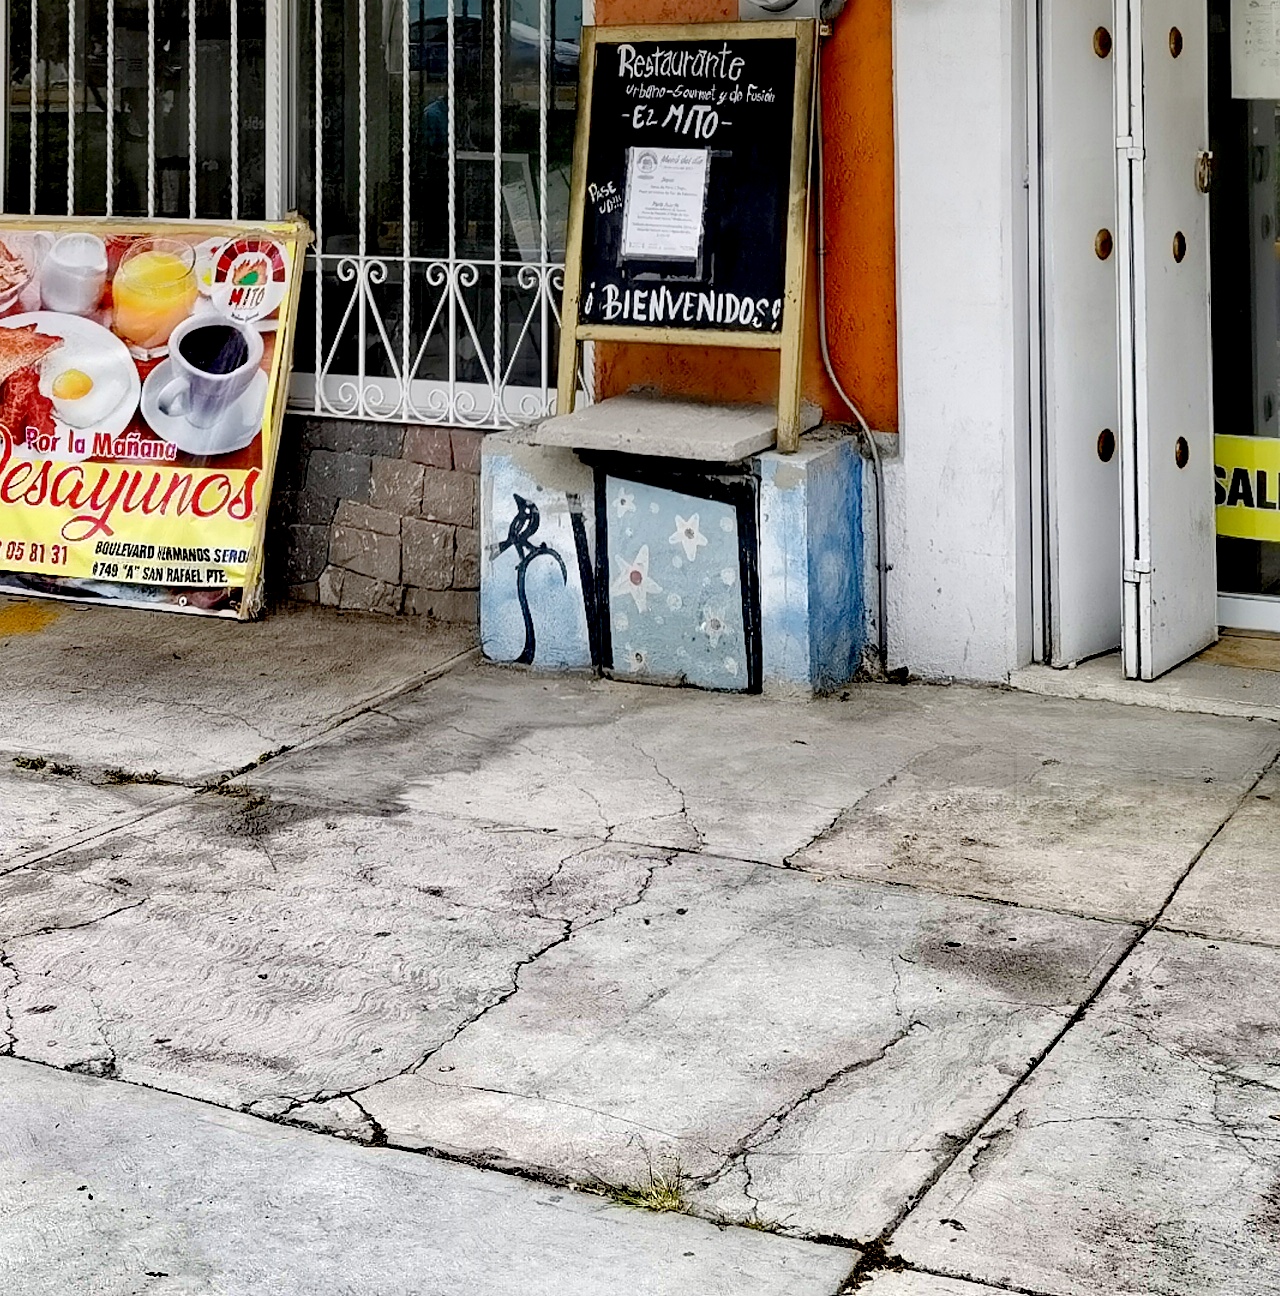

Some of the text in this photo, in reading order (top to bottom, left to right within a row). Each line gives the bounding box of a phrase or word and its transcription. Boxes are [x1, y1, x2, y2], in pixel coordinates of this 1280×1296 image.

[617, 42, 745, 80] Restaurante
[716, 90, 728, 105] y
[588, 181, 616, 204] PASE
[228, 287, 265, 306] MITO
[25, 427, 178, 459] Por la Mañana
[6, 541, 26, 560] 05
[29, 542, 45, 563] 81
[51, 545, 68, 565] 31
[95, 541, 155, 559] BOULEVARD
[214, 548, 250, 563] SERD
[142, 566, 163, 581] SAN
[166, 567, 203, 583] RAFAEL
[207, 569, 228, 583] PTE.
